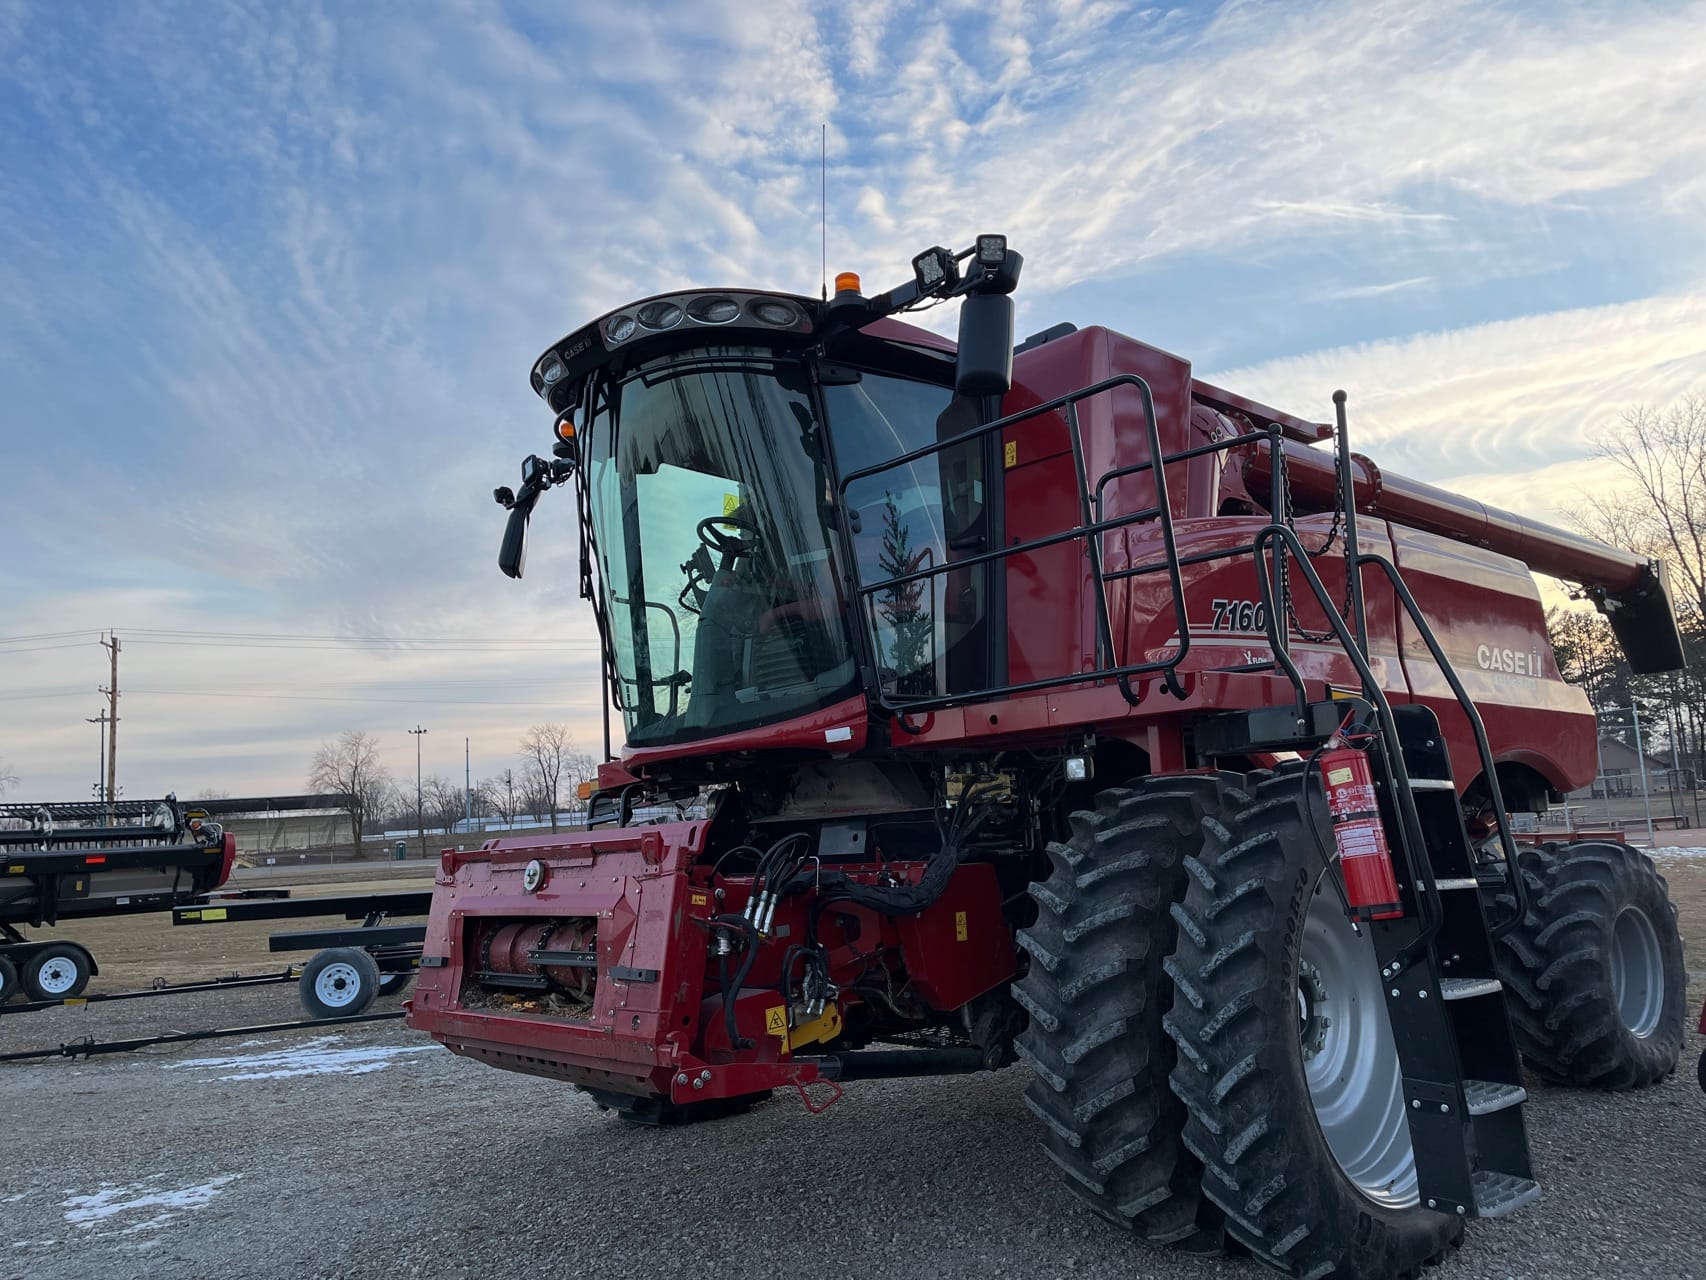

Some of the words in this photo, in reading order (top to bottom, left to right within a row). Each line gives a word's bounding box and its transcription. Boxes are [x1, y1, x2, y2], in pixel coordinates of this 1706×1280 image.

[564, 342, 585, 360] CASE
[1211, 599, 1266, 632] 7160
[1477, 644, 1526, 674] CASE
